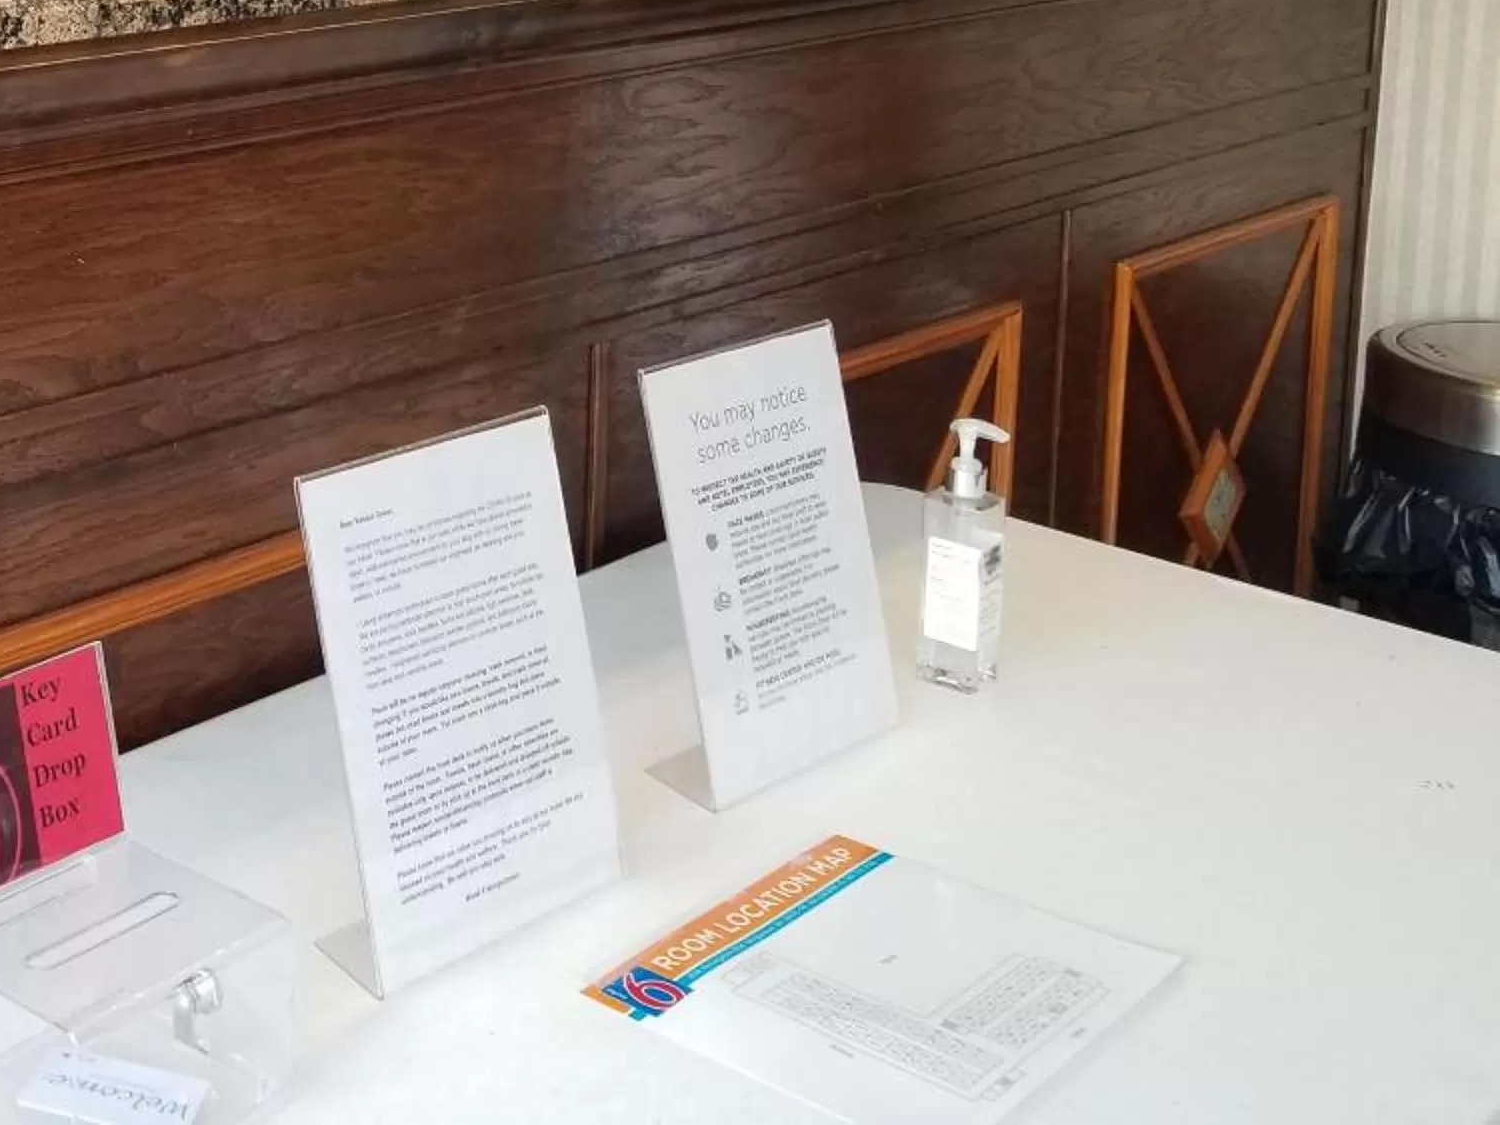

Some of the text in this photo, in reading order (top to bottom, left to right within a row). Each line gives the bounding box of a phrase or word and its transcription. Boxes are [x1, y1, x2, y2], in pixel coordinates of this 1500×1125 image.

[689, 386, 806, 433] You may notice
[698, 416, 810, 463] some changes.
[20, 677, 61, 707] Key
[27, 707, 77, 747] Card
[34, 753, 85, 788] Drop
[38, 796, 80, 828] Box
[652, 928, 725, 971] ROOM
[713, 872, 817, 934] LOCATION
[806, 848, 852, 876] MAP
[624, 972, 686, 1011] 6
